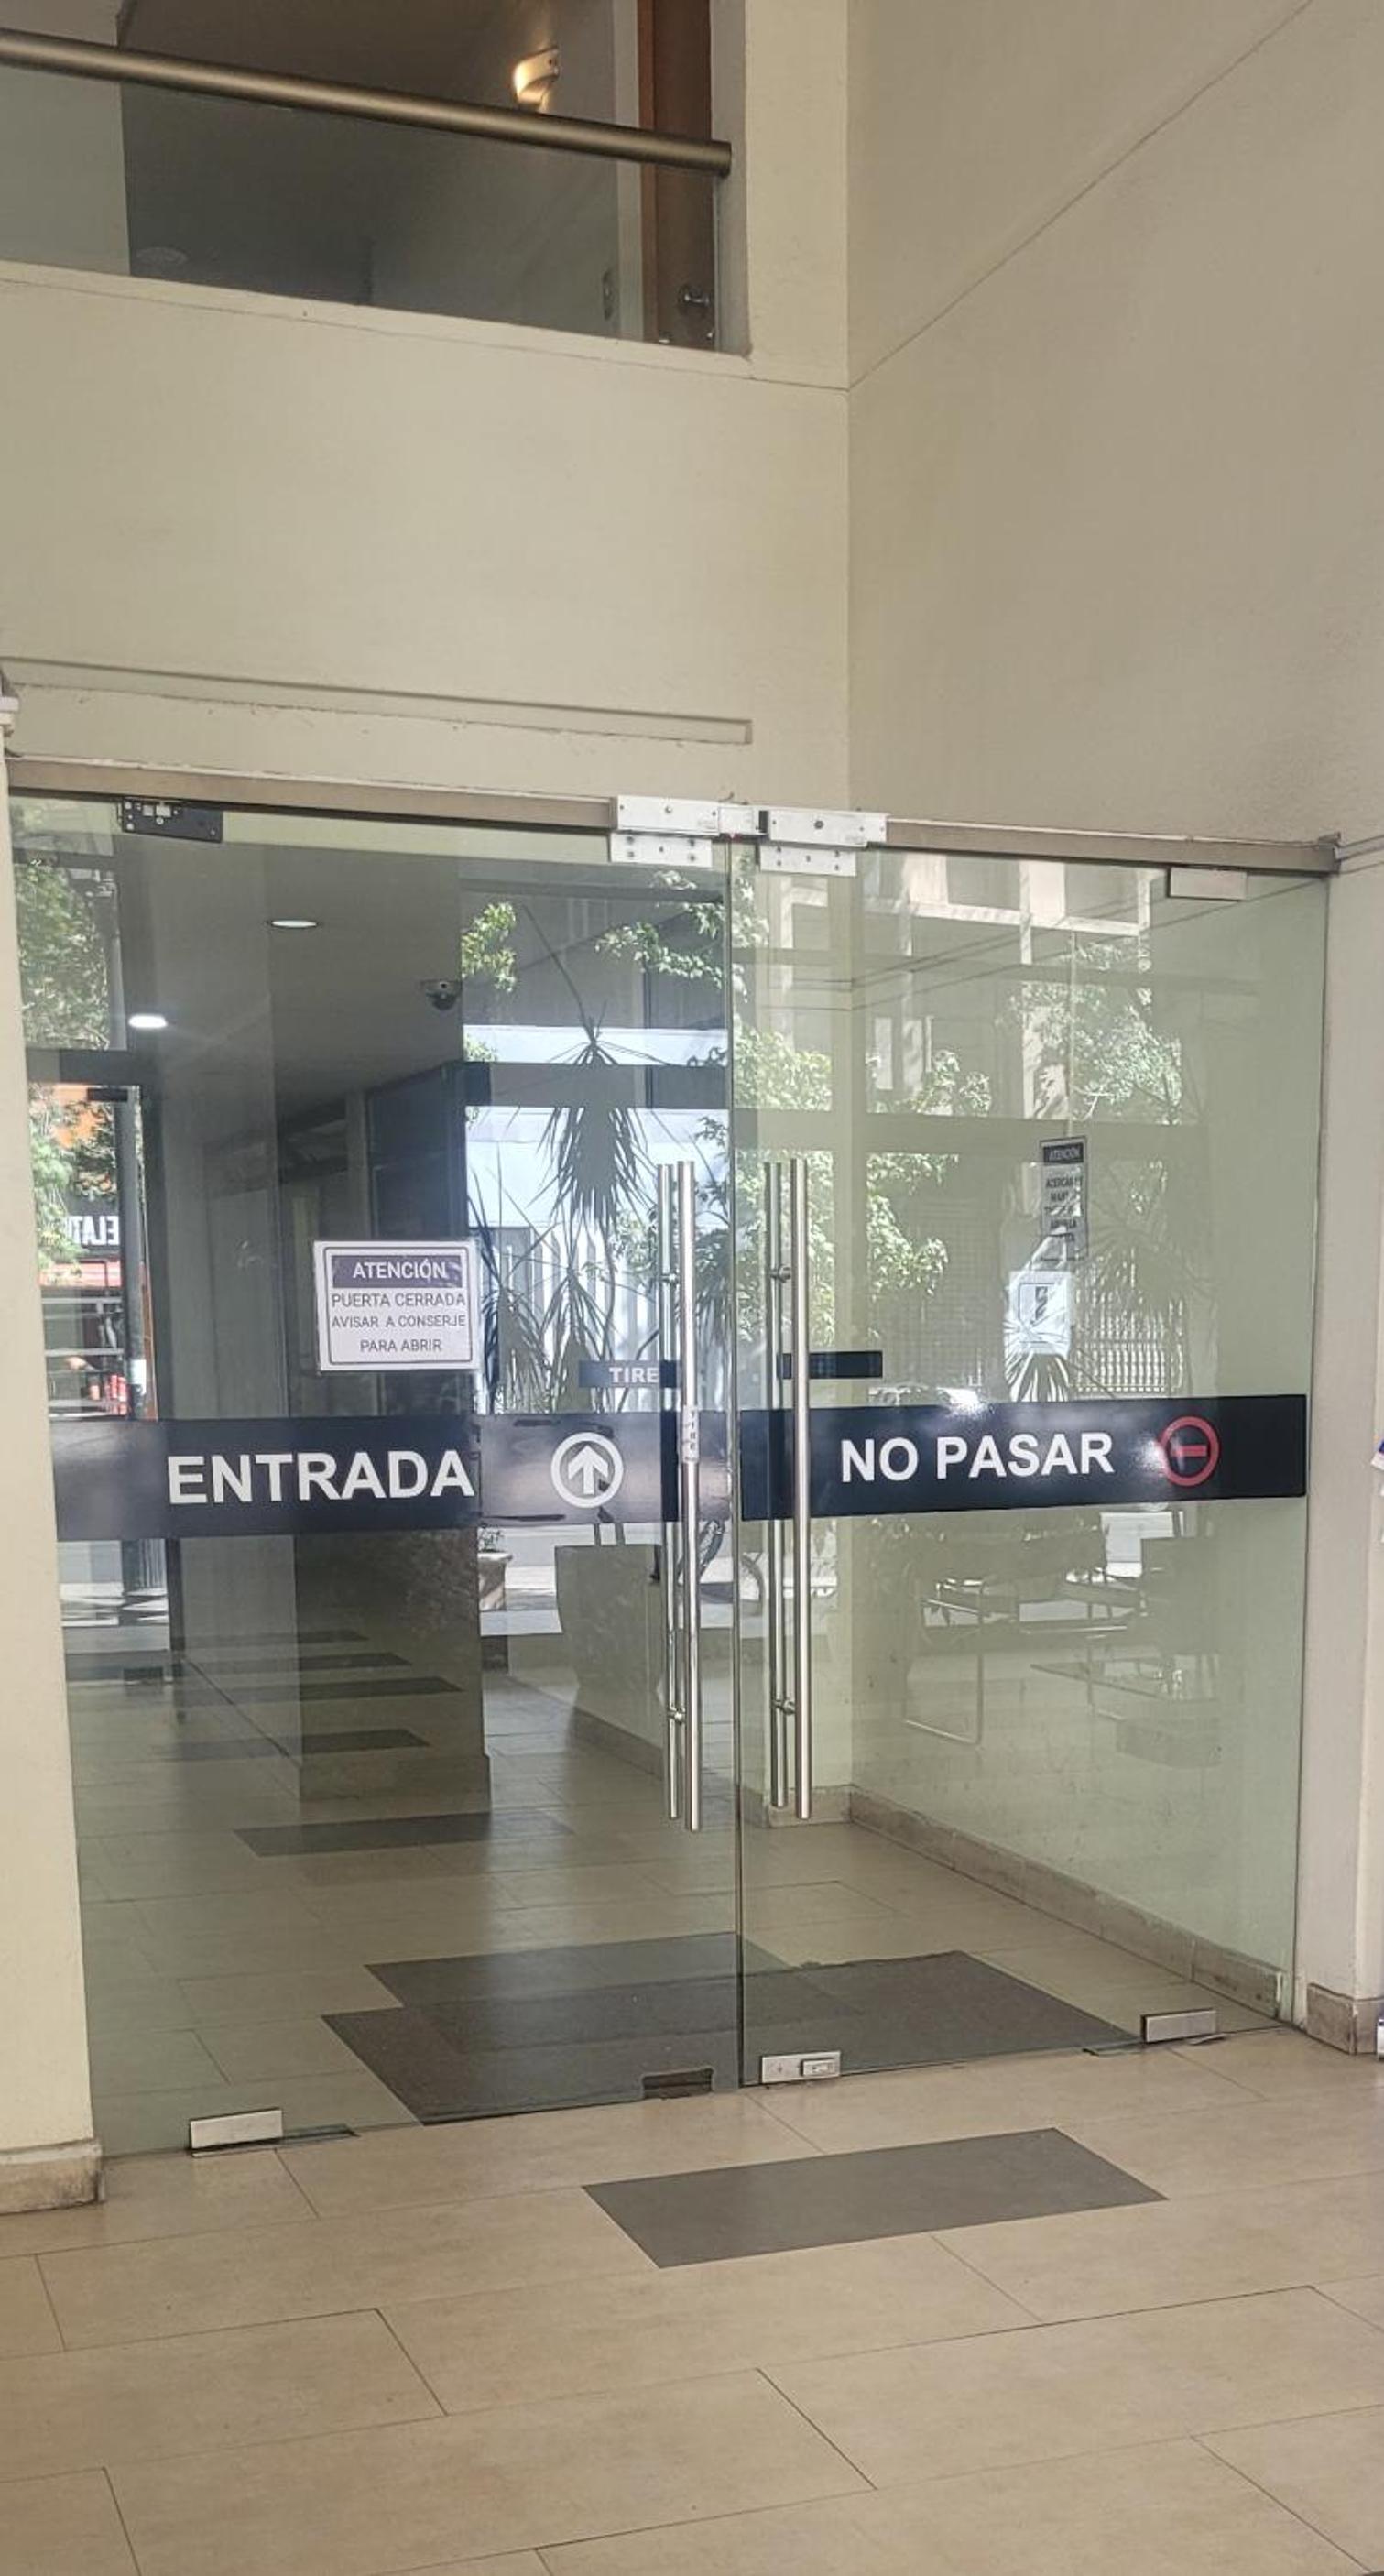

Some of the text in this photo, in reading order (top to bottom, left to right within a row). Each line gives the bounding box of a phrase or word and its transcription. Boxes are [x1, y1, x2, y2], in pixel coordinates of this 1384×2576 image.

[353, 1259, 447, 1280] ATENCIÓN
[332, 1293, 466, 1308] PUERTA CERRADA
[332, 1315, 466, 1328] AVISAR A CONSERJE
[360, 1338, 442, 1353] PARA ABRIR
[609, 1367, 660, 1384] TIRE
[842, 1431, 1115, 1482] NO PASAR
[168, 1450, 475, 1504] ENTRADA
